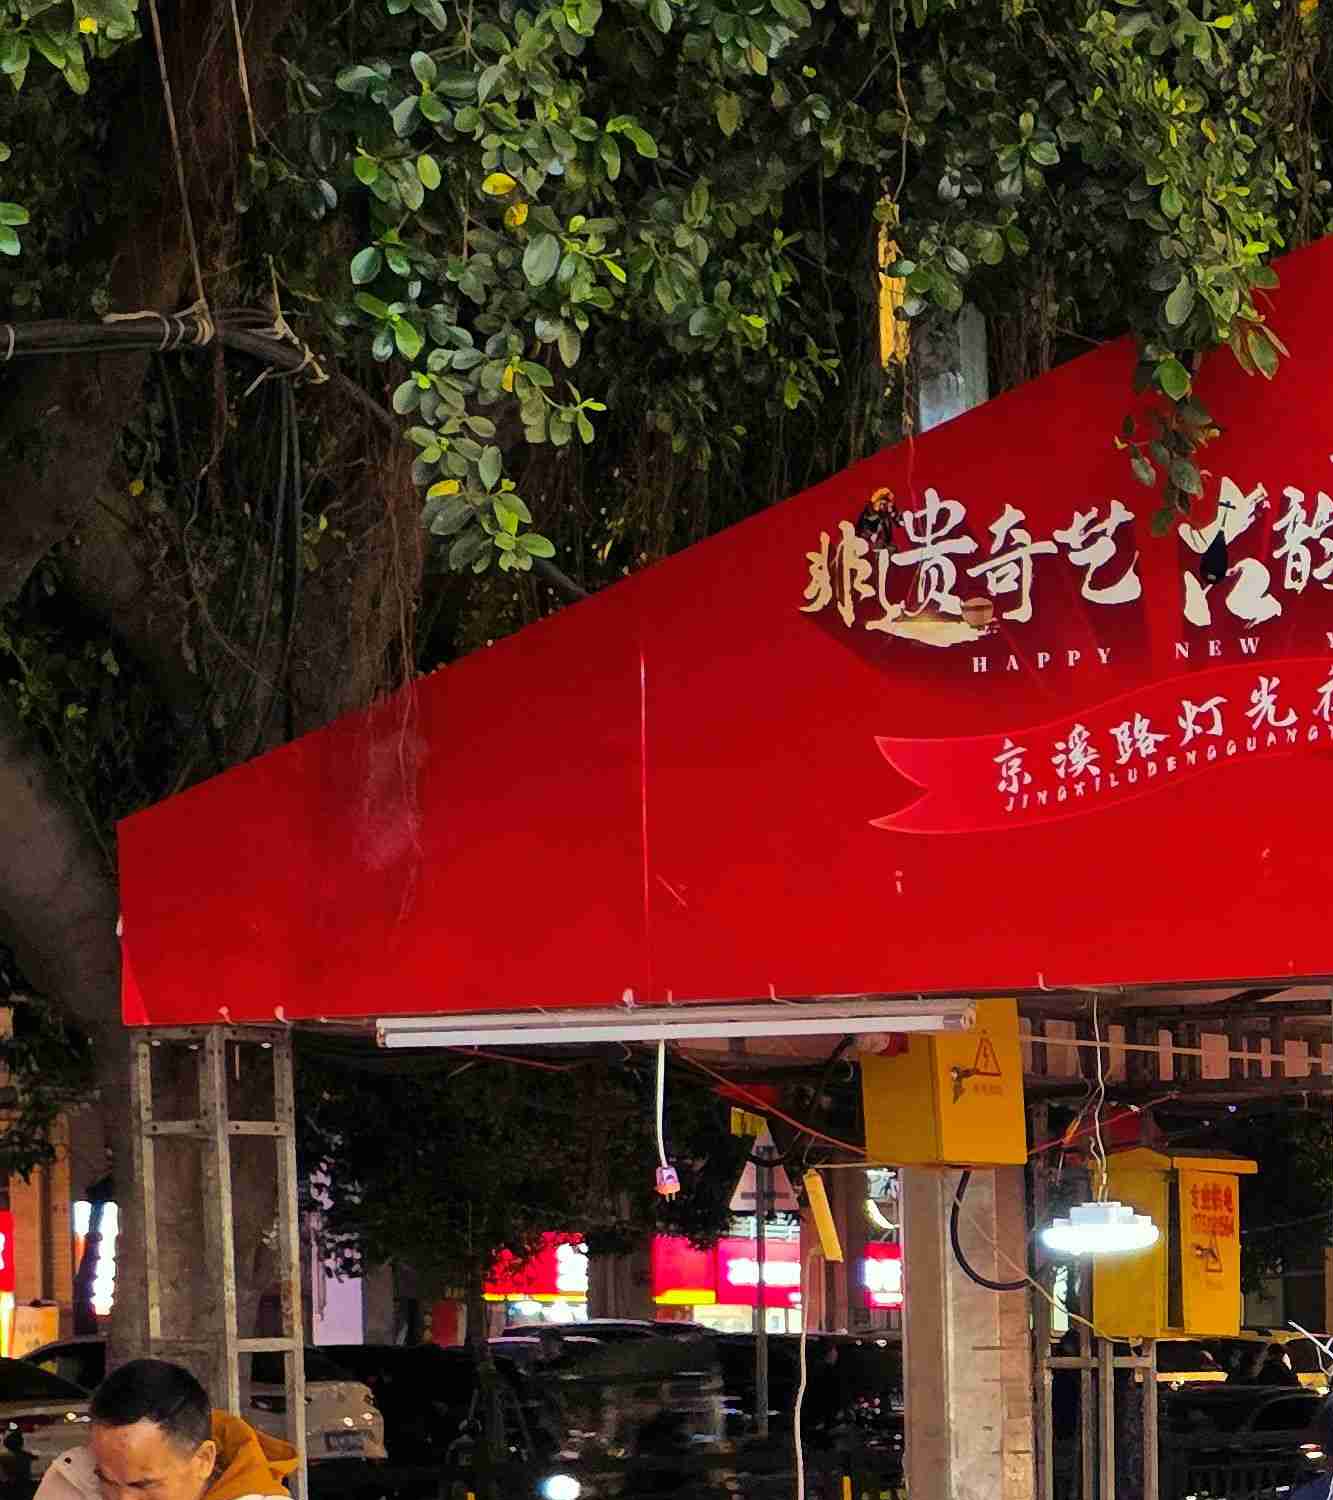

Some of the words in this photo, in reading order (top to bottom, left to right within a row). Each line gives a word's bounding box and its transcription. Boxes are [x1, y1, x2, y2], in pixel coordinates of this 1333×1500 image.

[798, 487, 1143, 649] 非遗奇艺
[971, 646, 1114, 675] HAPPY
[1174, 635, 1262, 661] NEW
